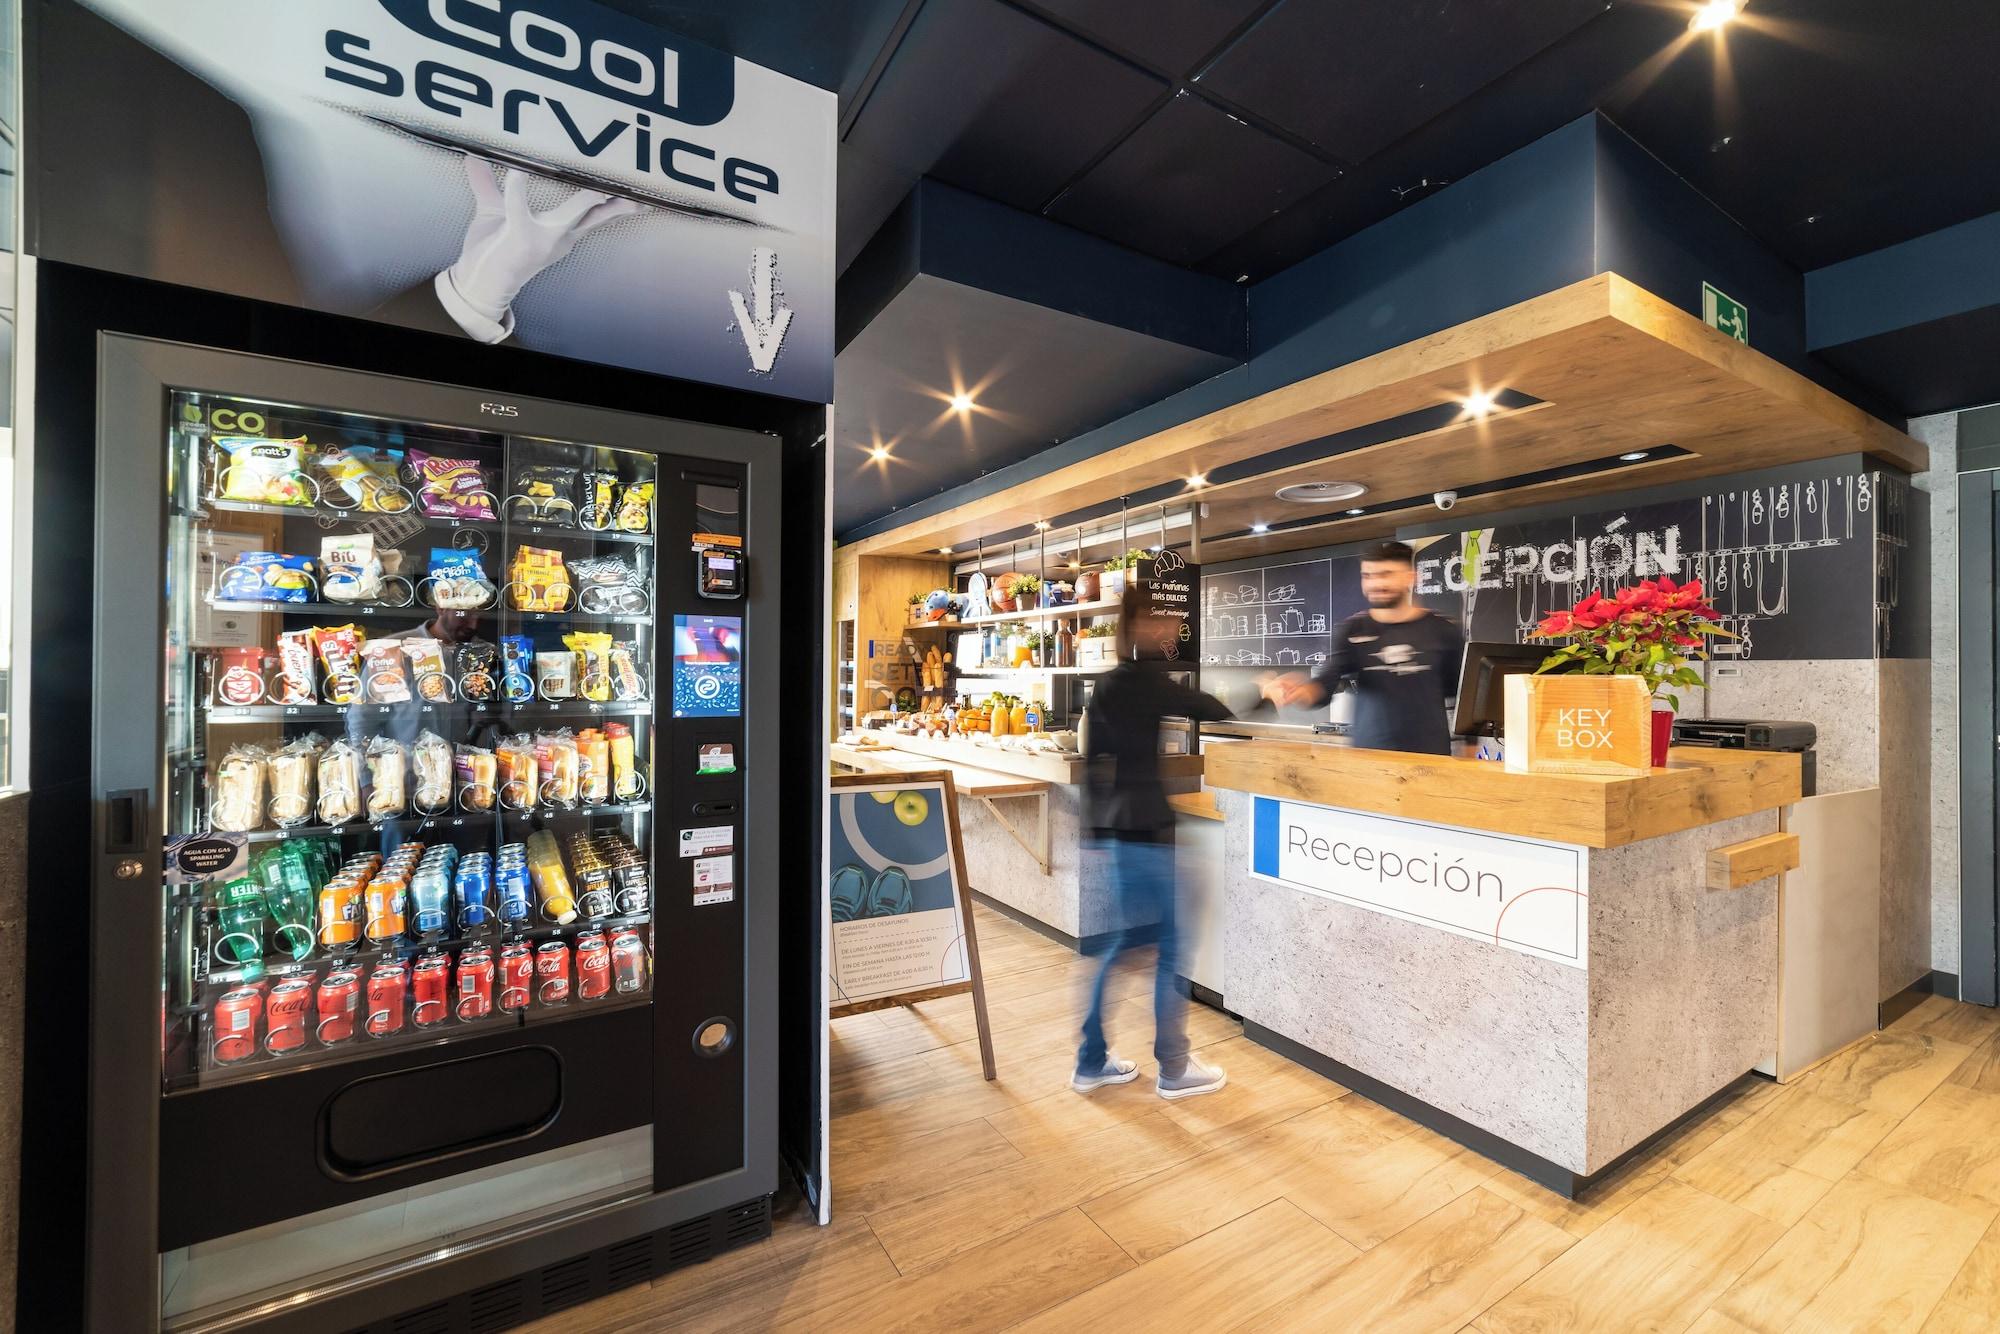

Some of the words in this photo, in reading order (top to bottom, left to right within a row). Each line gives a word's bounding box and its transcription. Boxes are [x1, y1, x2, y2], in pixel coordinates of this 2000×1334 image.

[1416, 513, 1680, 596] ECEPCIÓN
[1166, 593, 1188, 602] DULCES
[871, 663, 912, 681] SET
[1560, 708, 1612, 727] KEY
[1557, 730, 1614, 749] BOX
[1288, 824, 1503, 902] Recepción
